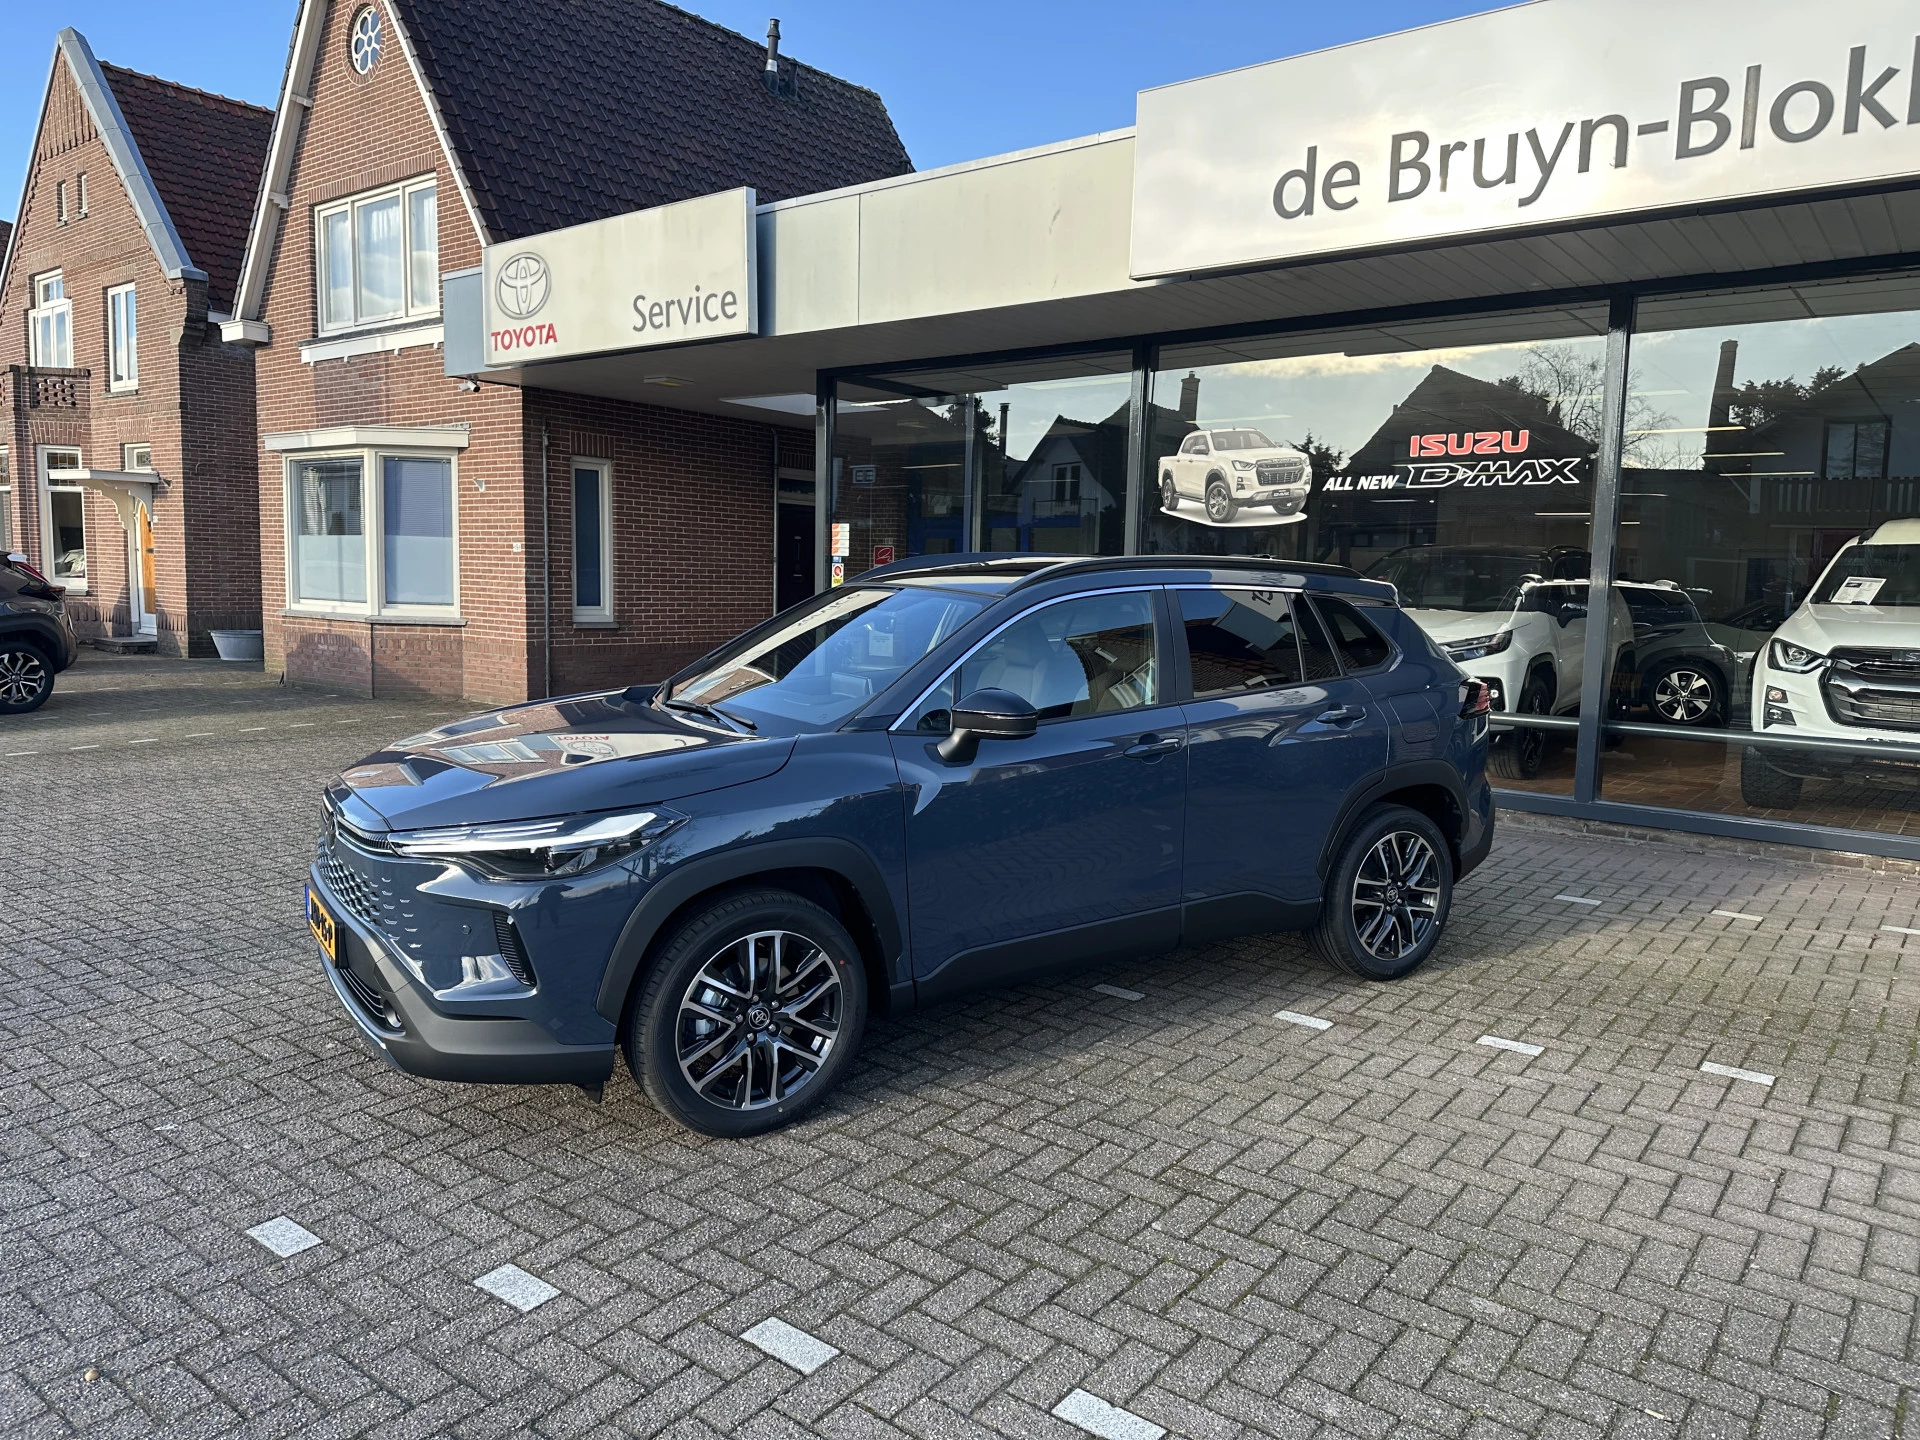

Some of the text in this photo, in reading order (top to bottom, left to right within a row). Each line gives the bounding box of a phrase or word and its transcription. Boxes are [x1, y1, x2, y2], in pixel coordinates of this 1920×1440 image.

[1272, 145, 1361, 220] de
[631, 284, 738, 333] Service
[490, 322, 558, 352] TOYOTA
[1409, 429, 1530, 458] ISUZU
[1322, 476, 1352, 492] ALL
[1357, 474, 1400, 491] NEW
